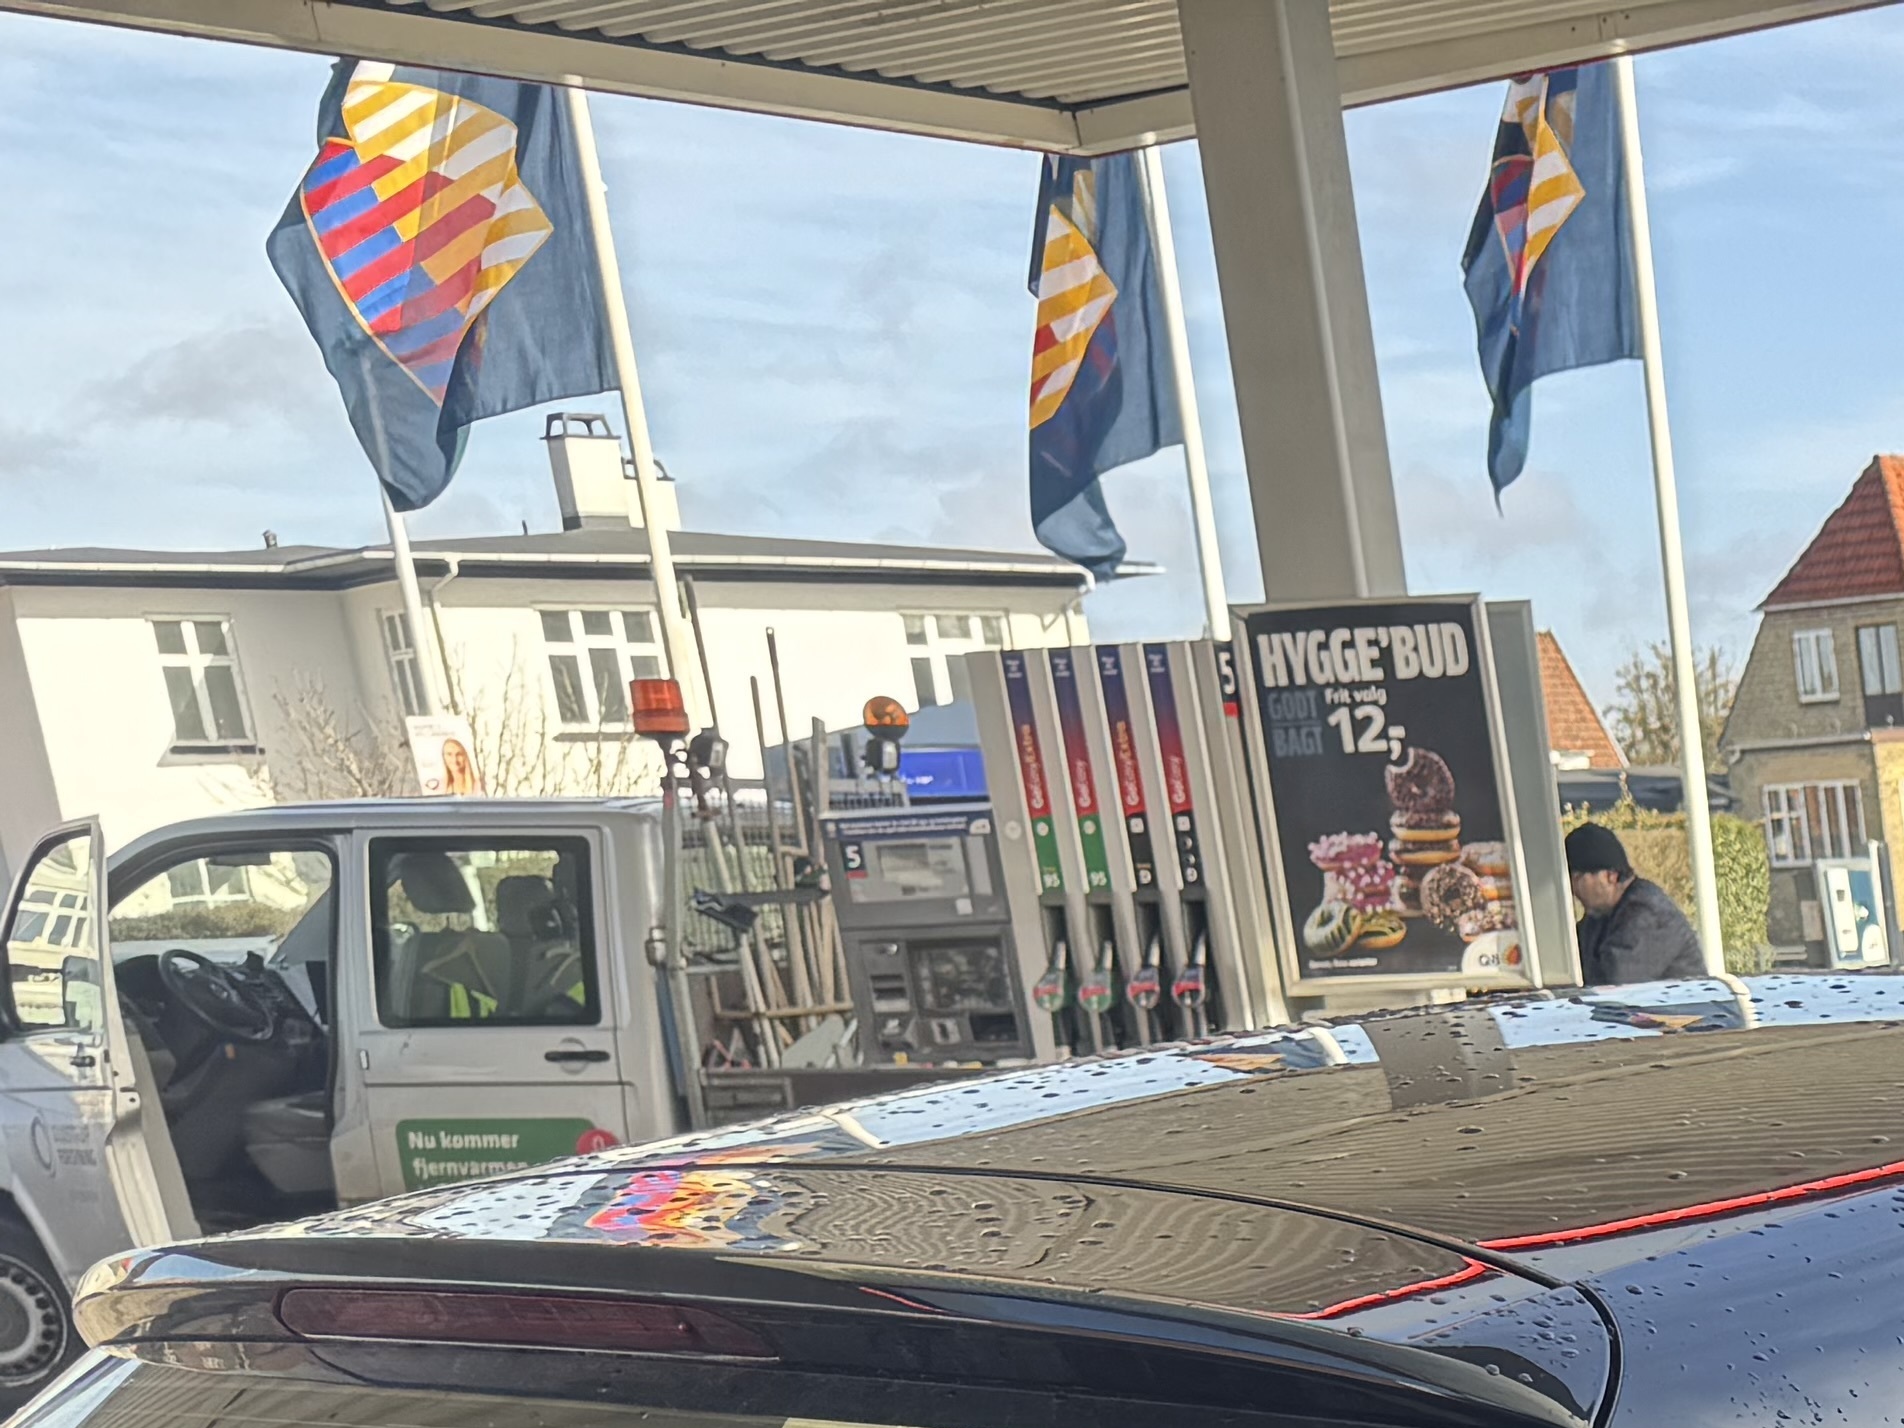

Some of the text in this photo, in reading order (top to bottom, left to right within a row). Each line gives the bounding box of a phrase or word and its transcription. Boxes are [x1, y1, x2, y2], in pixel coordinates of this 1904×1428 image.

[1257, 622, 1470, 688] HYGGE'BUD
[1218, 652, 1236, 694] 5
[1267, 689, 1318, 721] GODT
[1325, 685, 1388, 705] Frit valg
[1272, 725, 1323, 758] BAGT
[845, 845, 861, 869] 5
[408, 1131, 520, 1149] Nu kommer
